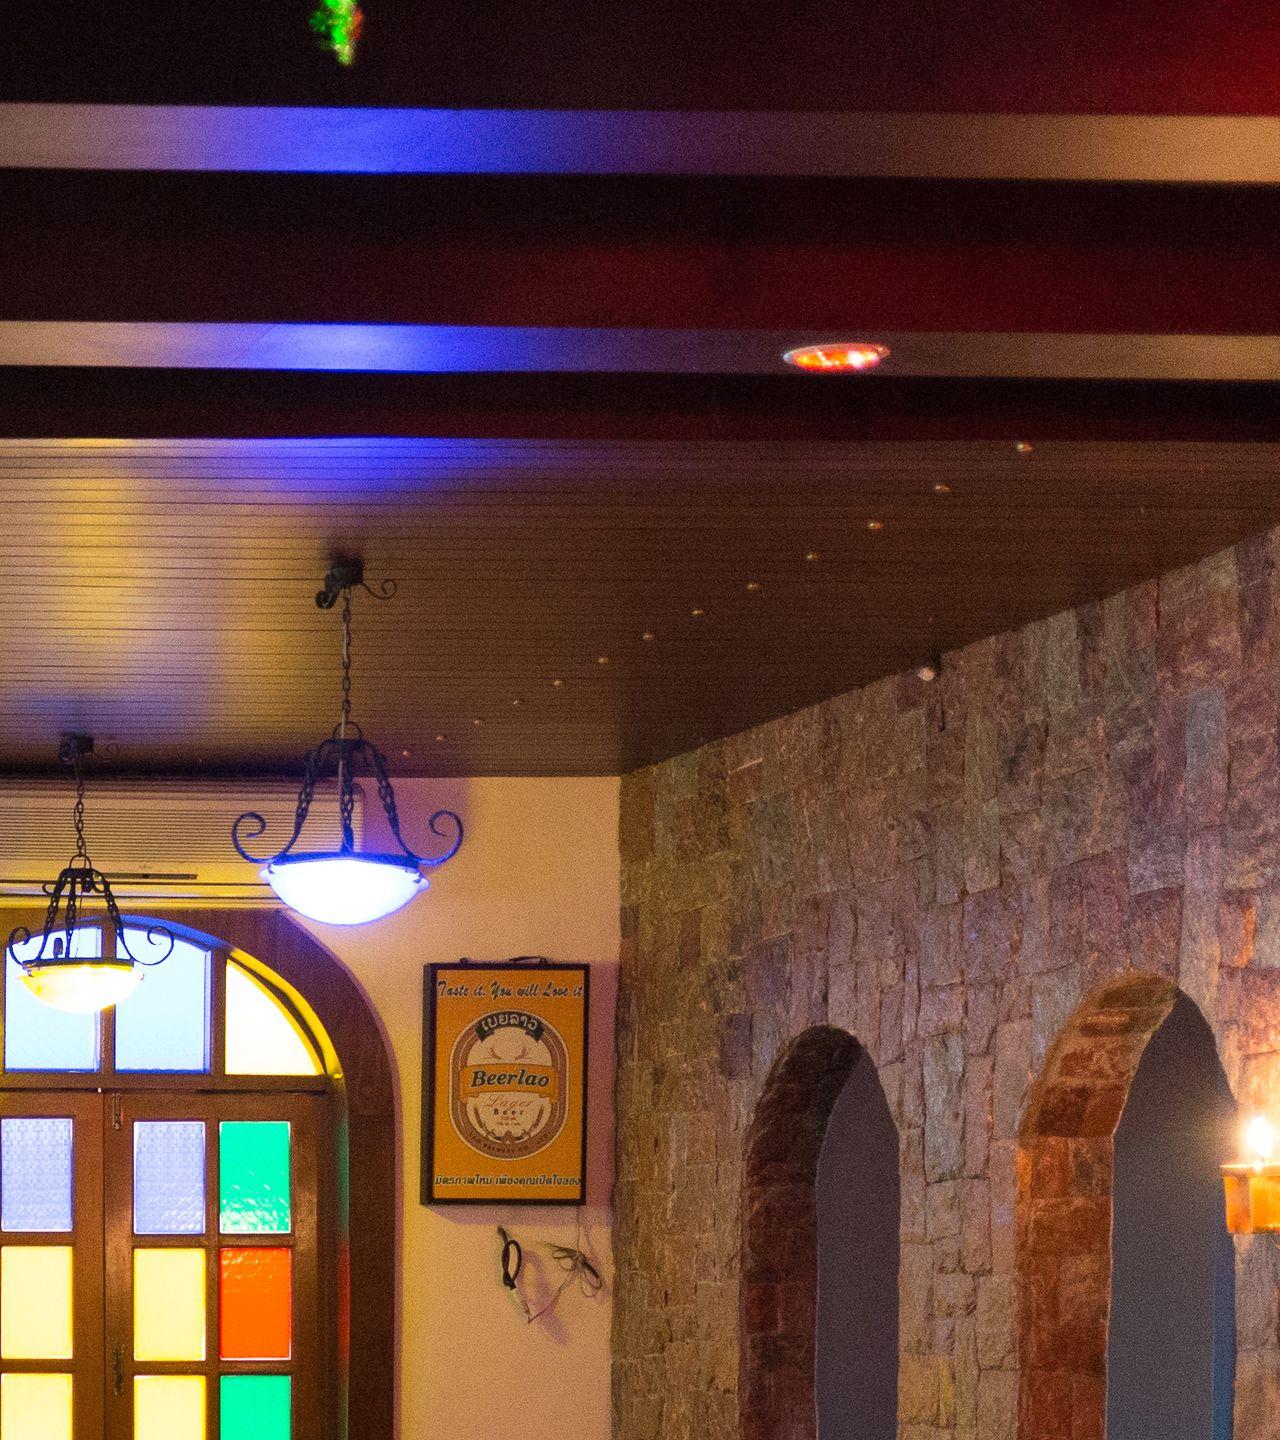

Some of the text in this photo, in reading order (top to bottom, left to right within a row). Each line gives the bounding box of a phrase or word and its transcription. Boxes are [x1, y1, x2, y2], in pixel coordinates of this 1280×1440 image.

[437, 980, 468, 997] Taste
[490, 980, 512, 1000] You
[517, 982, 540, 997] will
[542, 980, 569, 997] Love
[471, 1068, 550, 1088] Beerlao
[493, 1108, 524, 1116] Beer
